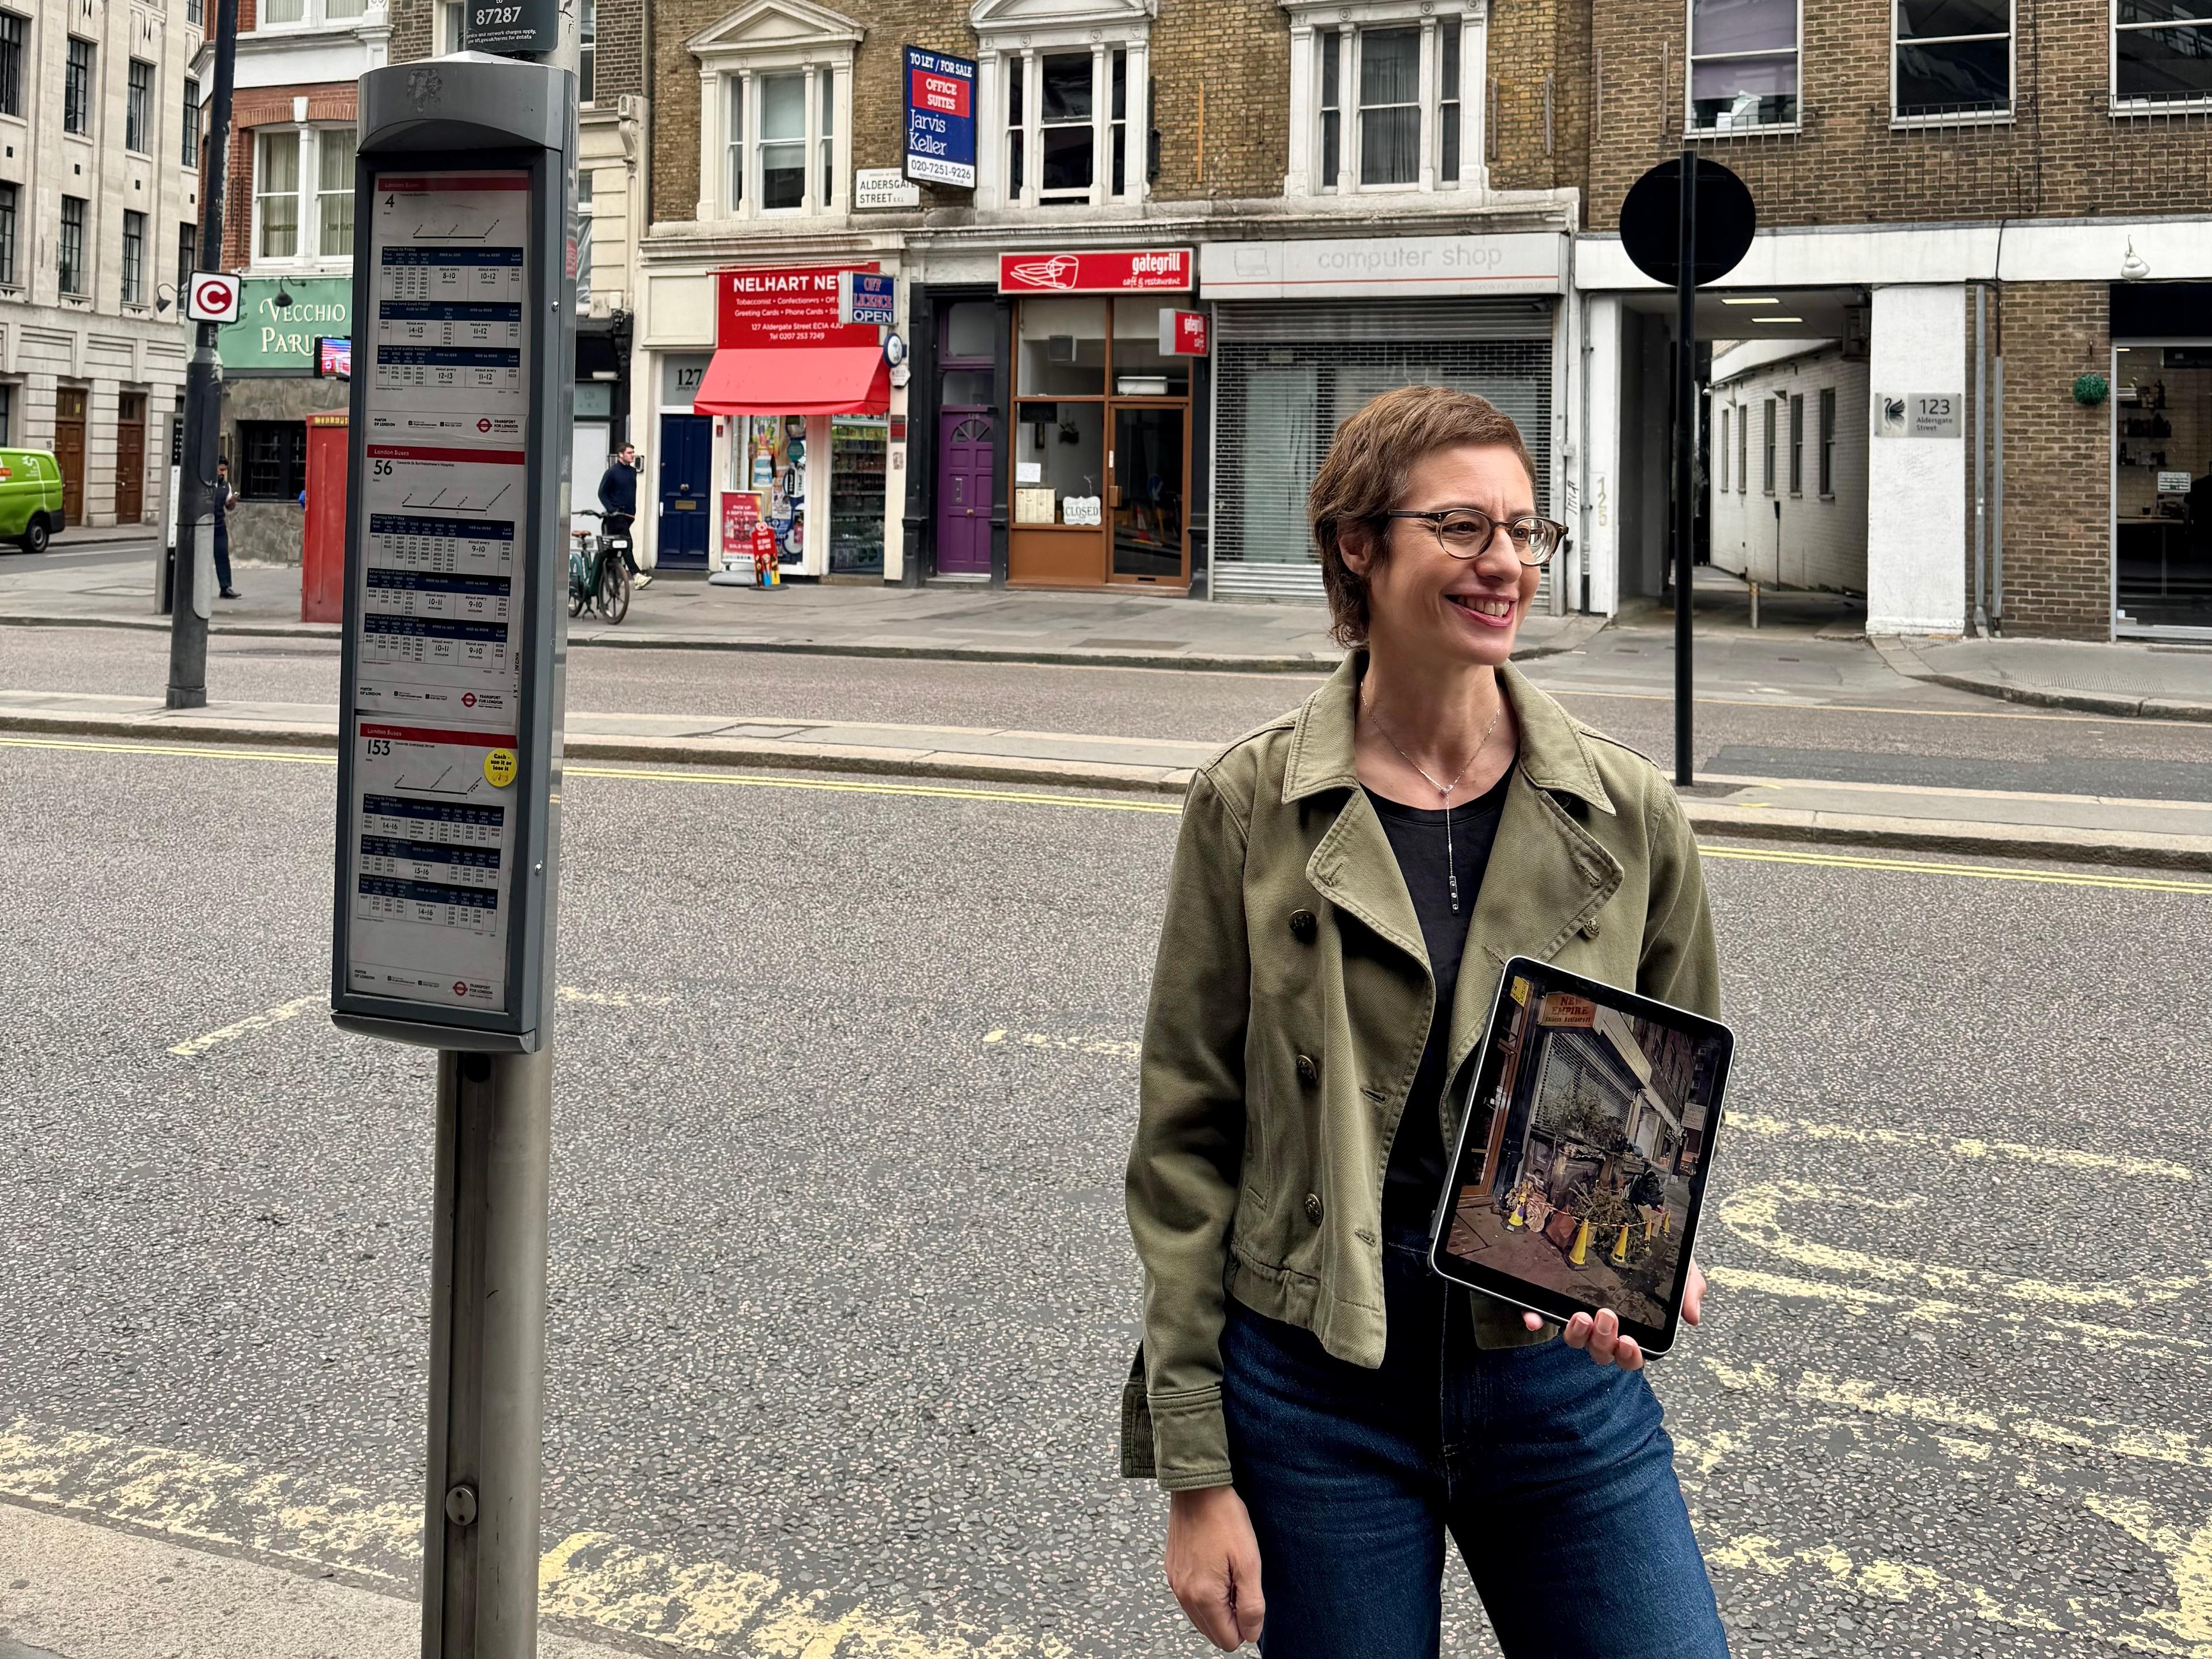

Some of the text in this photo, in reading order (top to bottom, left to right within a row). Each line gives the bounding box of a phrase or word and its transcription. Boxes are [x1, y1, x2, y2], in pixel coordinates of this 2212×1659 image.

[476, 6, 522, 25] 87287
[910, 52, 921, 66] TO
[921, 55, 934, 69] LET
[941, 60, 955, 74] FOR
[956, 64, 972, 78] SALE
[926, 78, 957, 95] OFFICE
[927, 94, 956, 110] SUITES
[910, 109, 946, 133] Jarvis
[909, 132, 948, 156] Keller
[911, 160, 971, 180] 020-7251-9226
[385, 194, 395, 208] 4
[860, 194, 892, 203] STREET
[1132, 253, 1180, 275] gategrill
[1318, 244, 1502, 273] computer shop
[733, 275, 839, 293] NELHART NE
[863, 278, 881, 291] OFF
[1145, 277, 1180, 286] restaurant
[853, 293, 892, 309] LICENCE
[259, 298, 346, 323] VECCHIO
[734, 309, 760, 317] Greeting
[854, 310, 892, 323] OPEN
[1184, 315, 1204, 334] gategrill
[262, 327, 332, 357] PARI
[677, 369, 703, 385] 127
[1919, 399, 1950, 414] 123
[373, 460, 392, 475] 56
[1066, 506, 1099, 517] CLOSED
[368, 739, 390, 756] 153
[1552, 1006, 1589, 1015] EMPIRE
